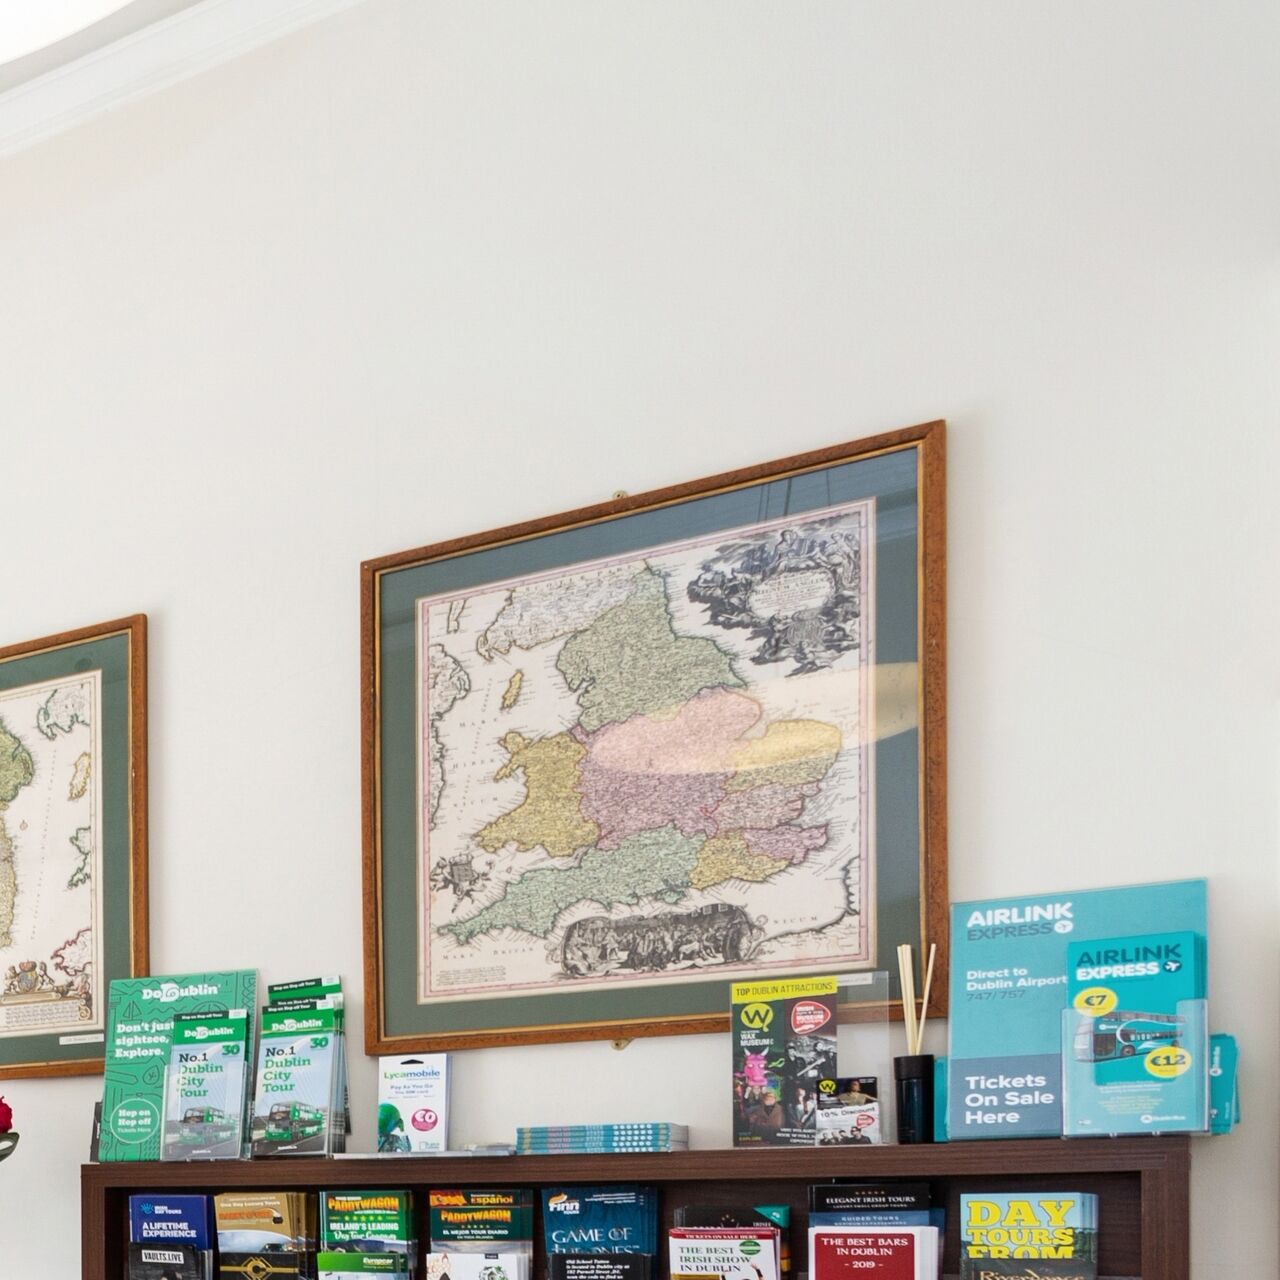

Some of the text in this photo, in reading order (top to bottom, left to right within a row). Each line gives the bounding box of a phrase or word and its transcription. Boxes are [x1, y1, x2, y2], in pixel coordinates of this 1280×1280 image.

[967, 902, 1073, 927] AIRLINK
[967, 923, 1052, 941] EXPRESS
[1077, 943, 1181, 967] AIRLINK
[967, 966, 1027, 980] Direct to
[1076, 962, 1159, 980] EXPRESS
[967, 974, 1067, 990] Dublin Airport
[736, 983, 832, 996] TOP DUBLIN ATTRACTIONS
[967, 989, 1025, 1001] 747/757
[1085, 995, 1106, 1006] €7
[117, 1021, 174, 1033] Don't just
[116, 1035, 169, 1046] sightsee,
[310, 1037, 328, 1048] 30
[115, 1048, 163, 1058] Explore.
[222, 1045, 240, 1055] 30
[265, 1046, 296, 1057] No.1
[179, 1053, 208, 1062] No.1
[1151, 1054, 1186, 1066] €12
[179, 1064, 223, 1074] Dublin
[265, 1058, 310, 1069] Dublin
[264, 1071, 291, 1082] City
[384, 1070, 440, 1079] Lycamobile
[177, 1076, 204, 1087] City
[965, 1074, 1047, 1090] Tickets
[177, 1089, 208, 1098] Tour
[263, 1083, 295, 1093] Tour
[965, 1092, 1054, 1106] On Sale
[119, 1109, 137, 1118] Hop
[965, 1110, 1019, 1124] Here
[118, 1119, 137, 1127] Hop
[328, 1197, 399, 1212] PADDYWAGON
[471, 1195, 513, 1204] Español
[441, 1210, 511, 1223] PADDYWAGON
[966, 1200, 1074, 1227] DAY
[143, 1230, 197, 1238] EXPERIENCE
[552, 1227, 604, 1244] GAME
[967, 1228, 1074, 1246] TOURS
[821, 1238, 908, 1246] THE BEST BARS
[679, 1246, 735, 1255] THE BEST
[837, 1247, 892, 1256] IN DUBLIN
[144, 1252, 182, 1262] VAULTS.LIVE
[679, 1256, 752, 1264] IRISH SHOW
[680, 1263, 742, 1273] IN DUBLIN
[852, 1260, 876, 1269] 2019
